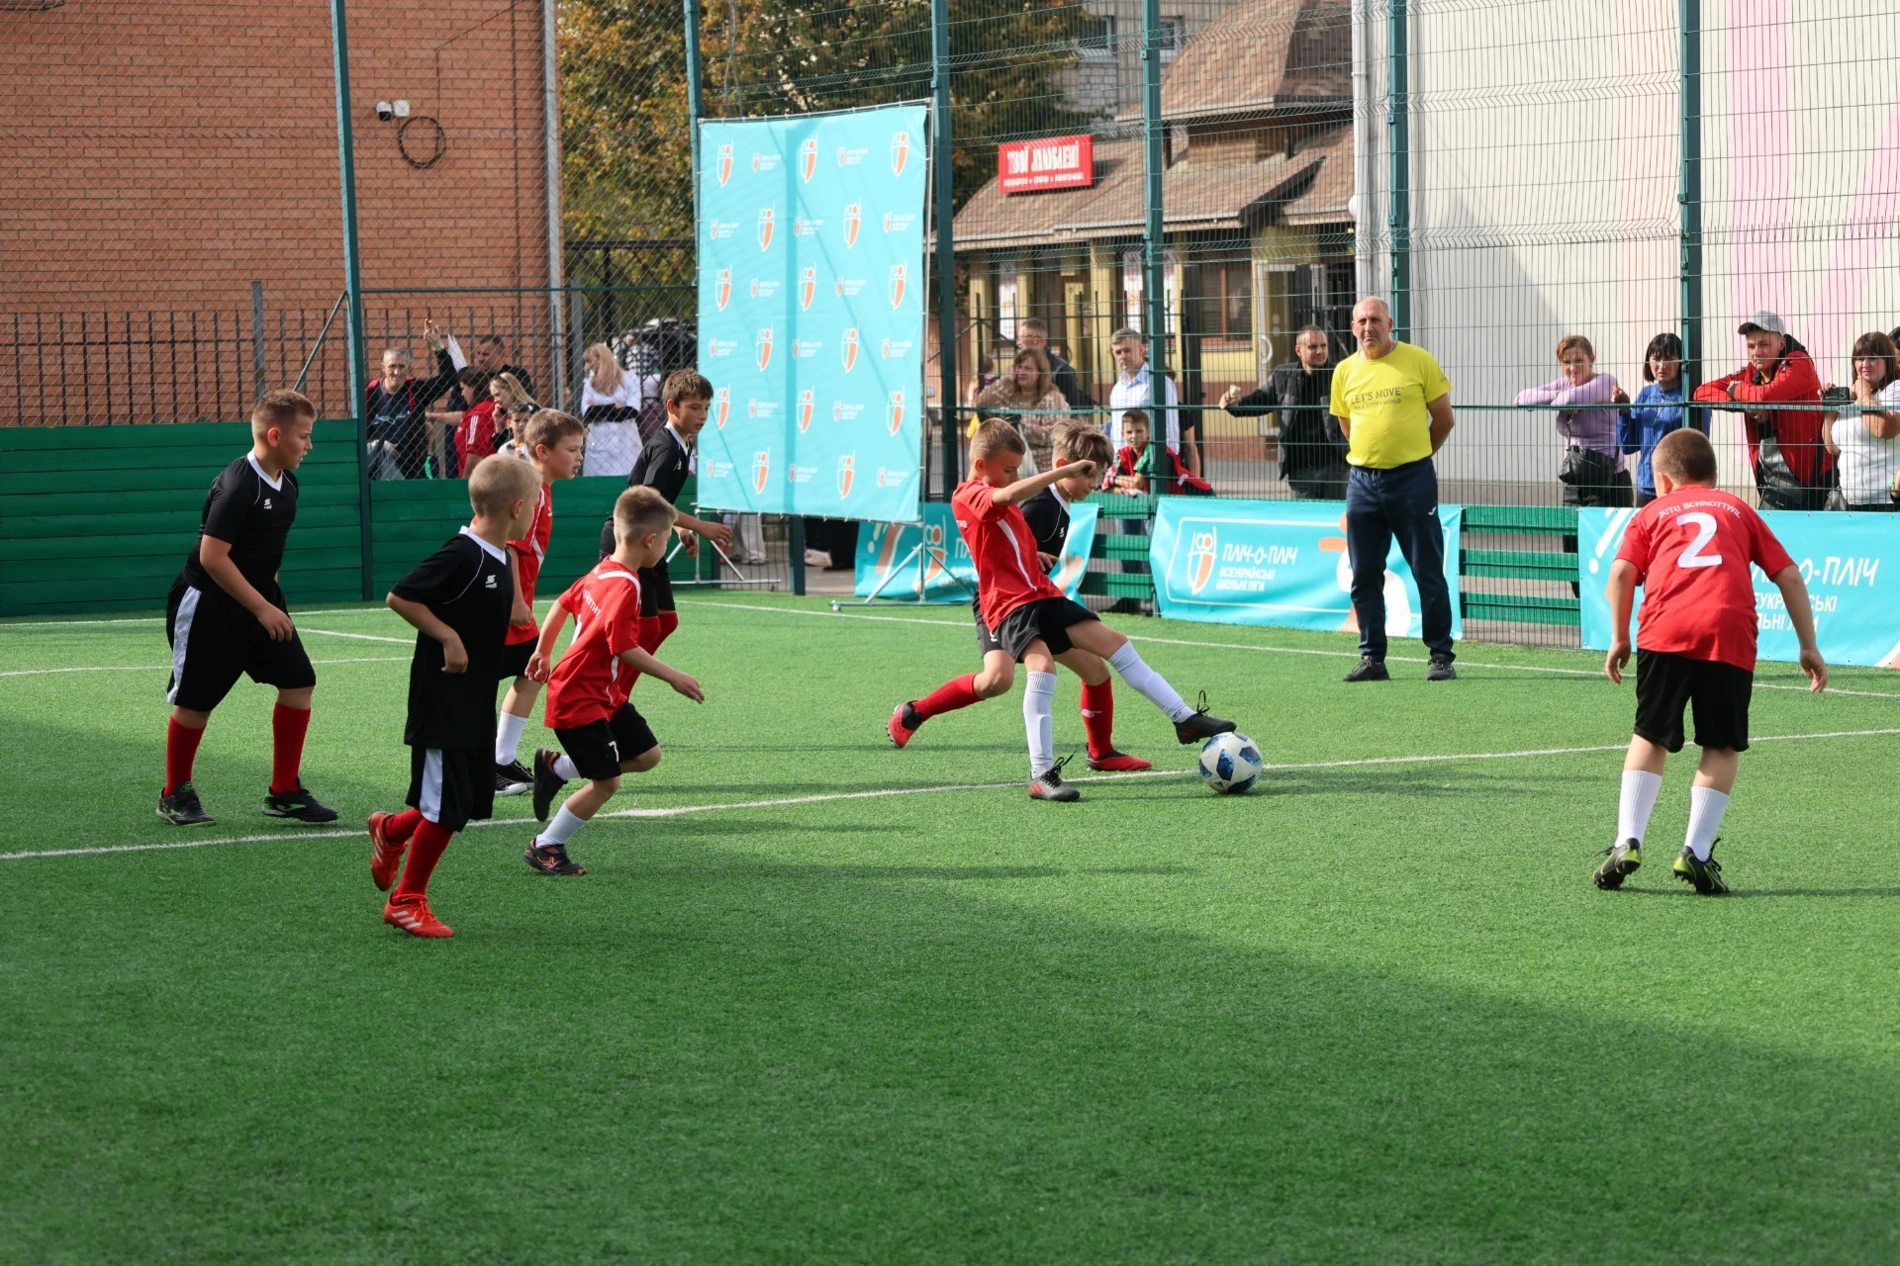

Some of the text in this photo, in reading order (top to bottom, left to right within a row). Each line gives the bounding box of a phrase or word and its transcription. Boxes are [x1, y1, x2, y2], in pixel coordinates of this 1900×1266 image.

[1351, 391, 1374, 405] LET'S
[1658, 501, 1741, 519] JUTU SCHNOTTWIL
[1676, 512, 1723, 568] 2
[1222, 544, 1299, 565] ПЛІЧ-О-ПЛІЧ
